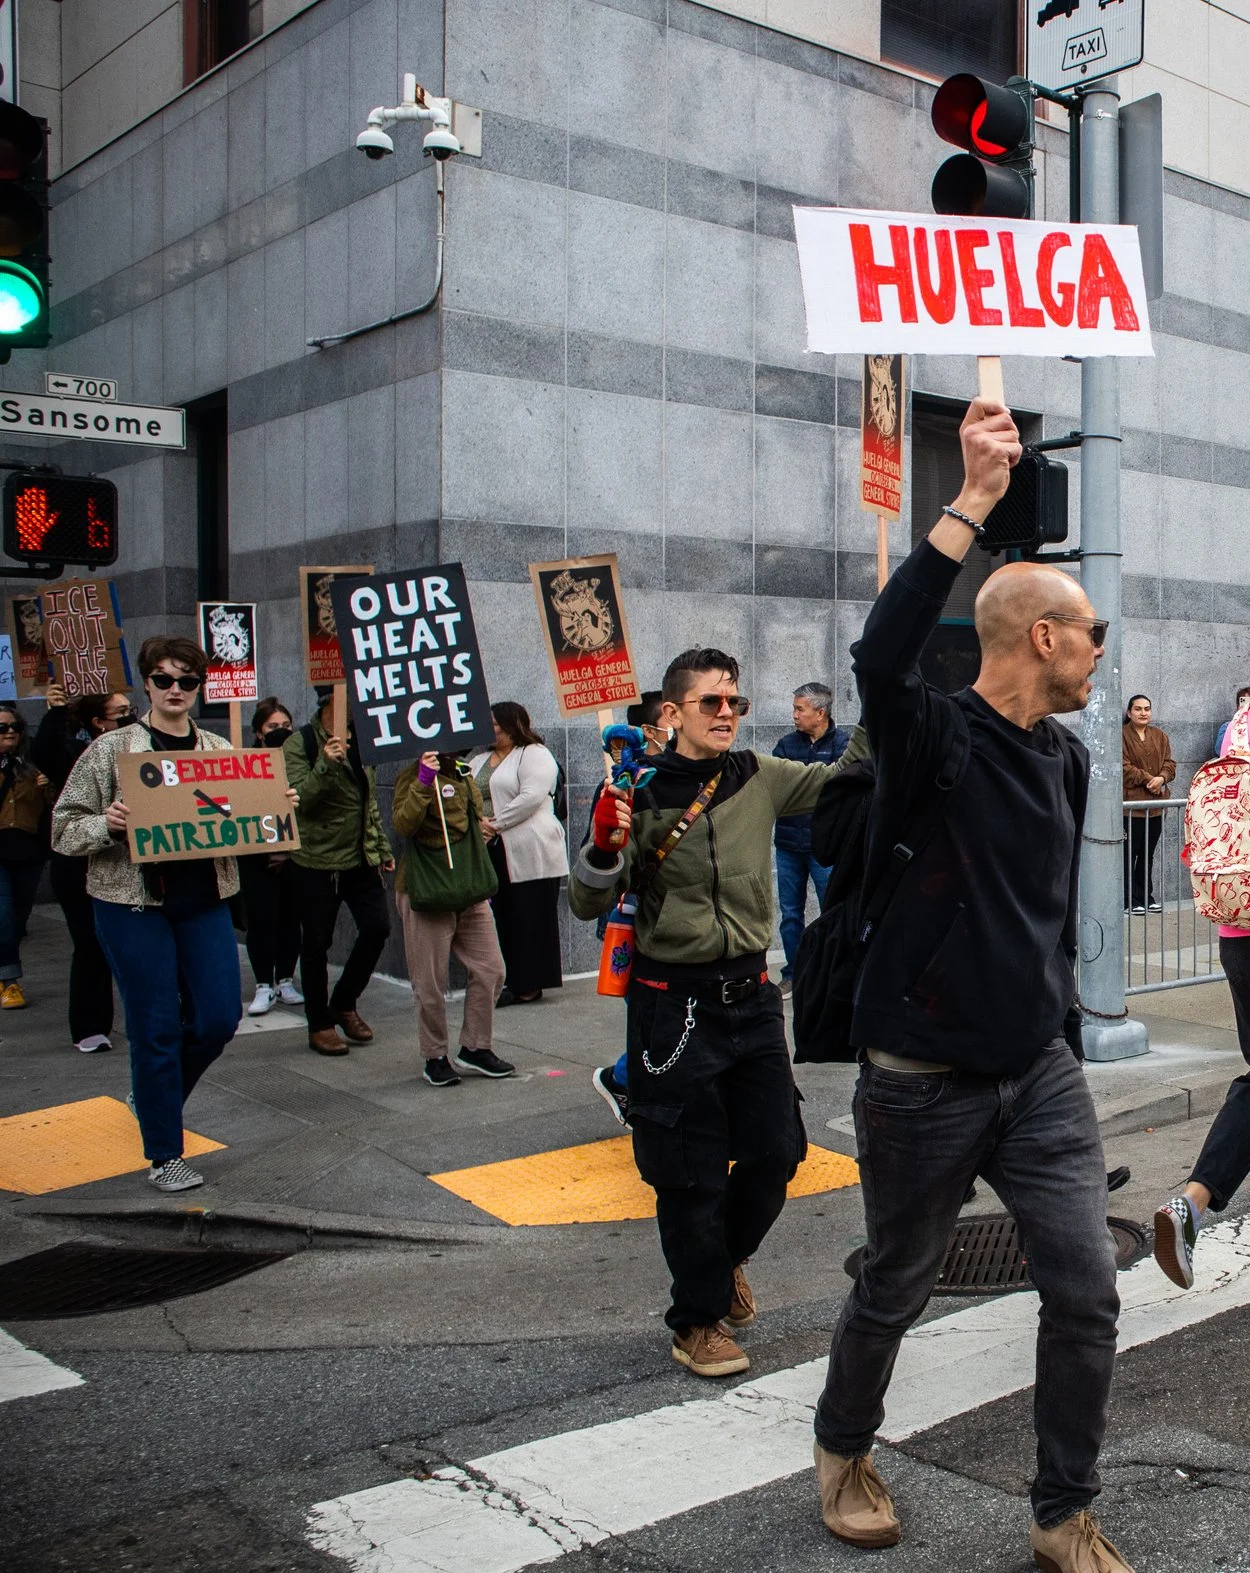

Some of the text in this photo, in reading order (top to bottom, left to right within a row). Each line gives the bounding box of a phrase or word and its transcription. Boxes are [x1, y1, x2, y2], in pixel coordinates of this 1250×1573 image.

[1069, 36, 1100, 60] TAXI
[848, 223, 1140, 331] HUELGA
[73, 379, 111, 398] 700
[0, 399, 161, 437] Sansome
[45, 584, 101, 617] ICE
[351, 576, 456, 621] OUR
[49, 612, 107, 651] OUT
[351, 612, 461, 662] HEAT
[54, 645, 106, 674] THE
[310, 648, 339, 660] HUELGA
[64, 669, 108, 697] BAY
[311, 668, 343, 679] GENERAL
[353, 652, 472, 703] MELTS
[560, 660, 631, 683] HUELGA GENERAL
[575, 676, 622, 692] OCTOBER 24
[566, 684, 635, 708] GENERAL STRIKE
[367, 693, 474, 747] ICE
[140, 753, 274, 789] OBEDIENCE
[134, 813, 294, 857] PATRIOTISM
